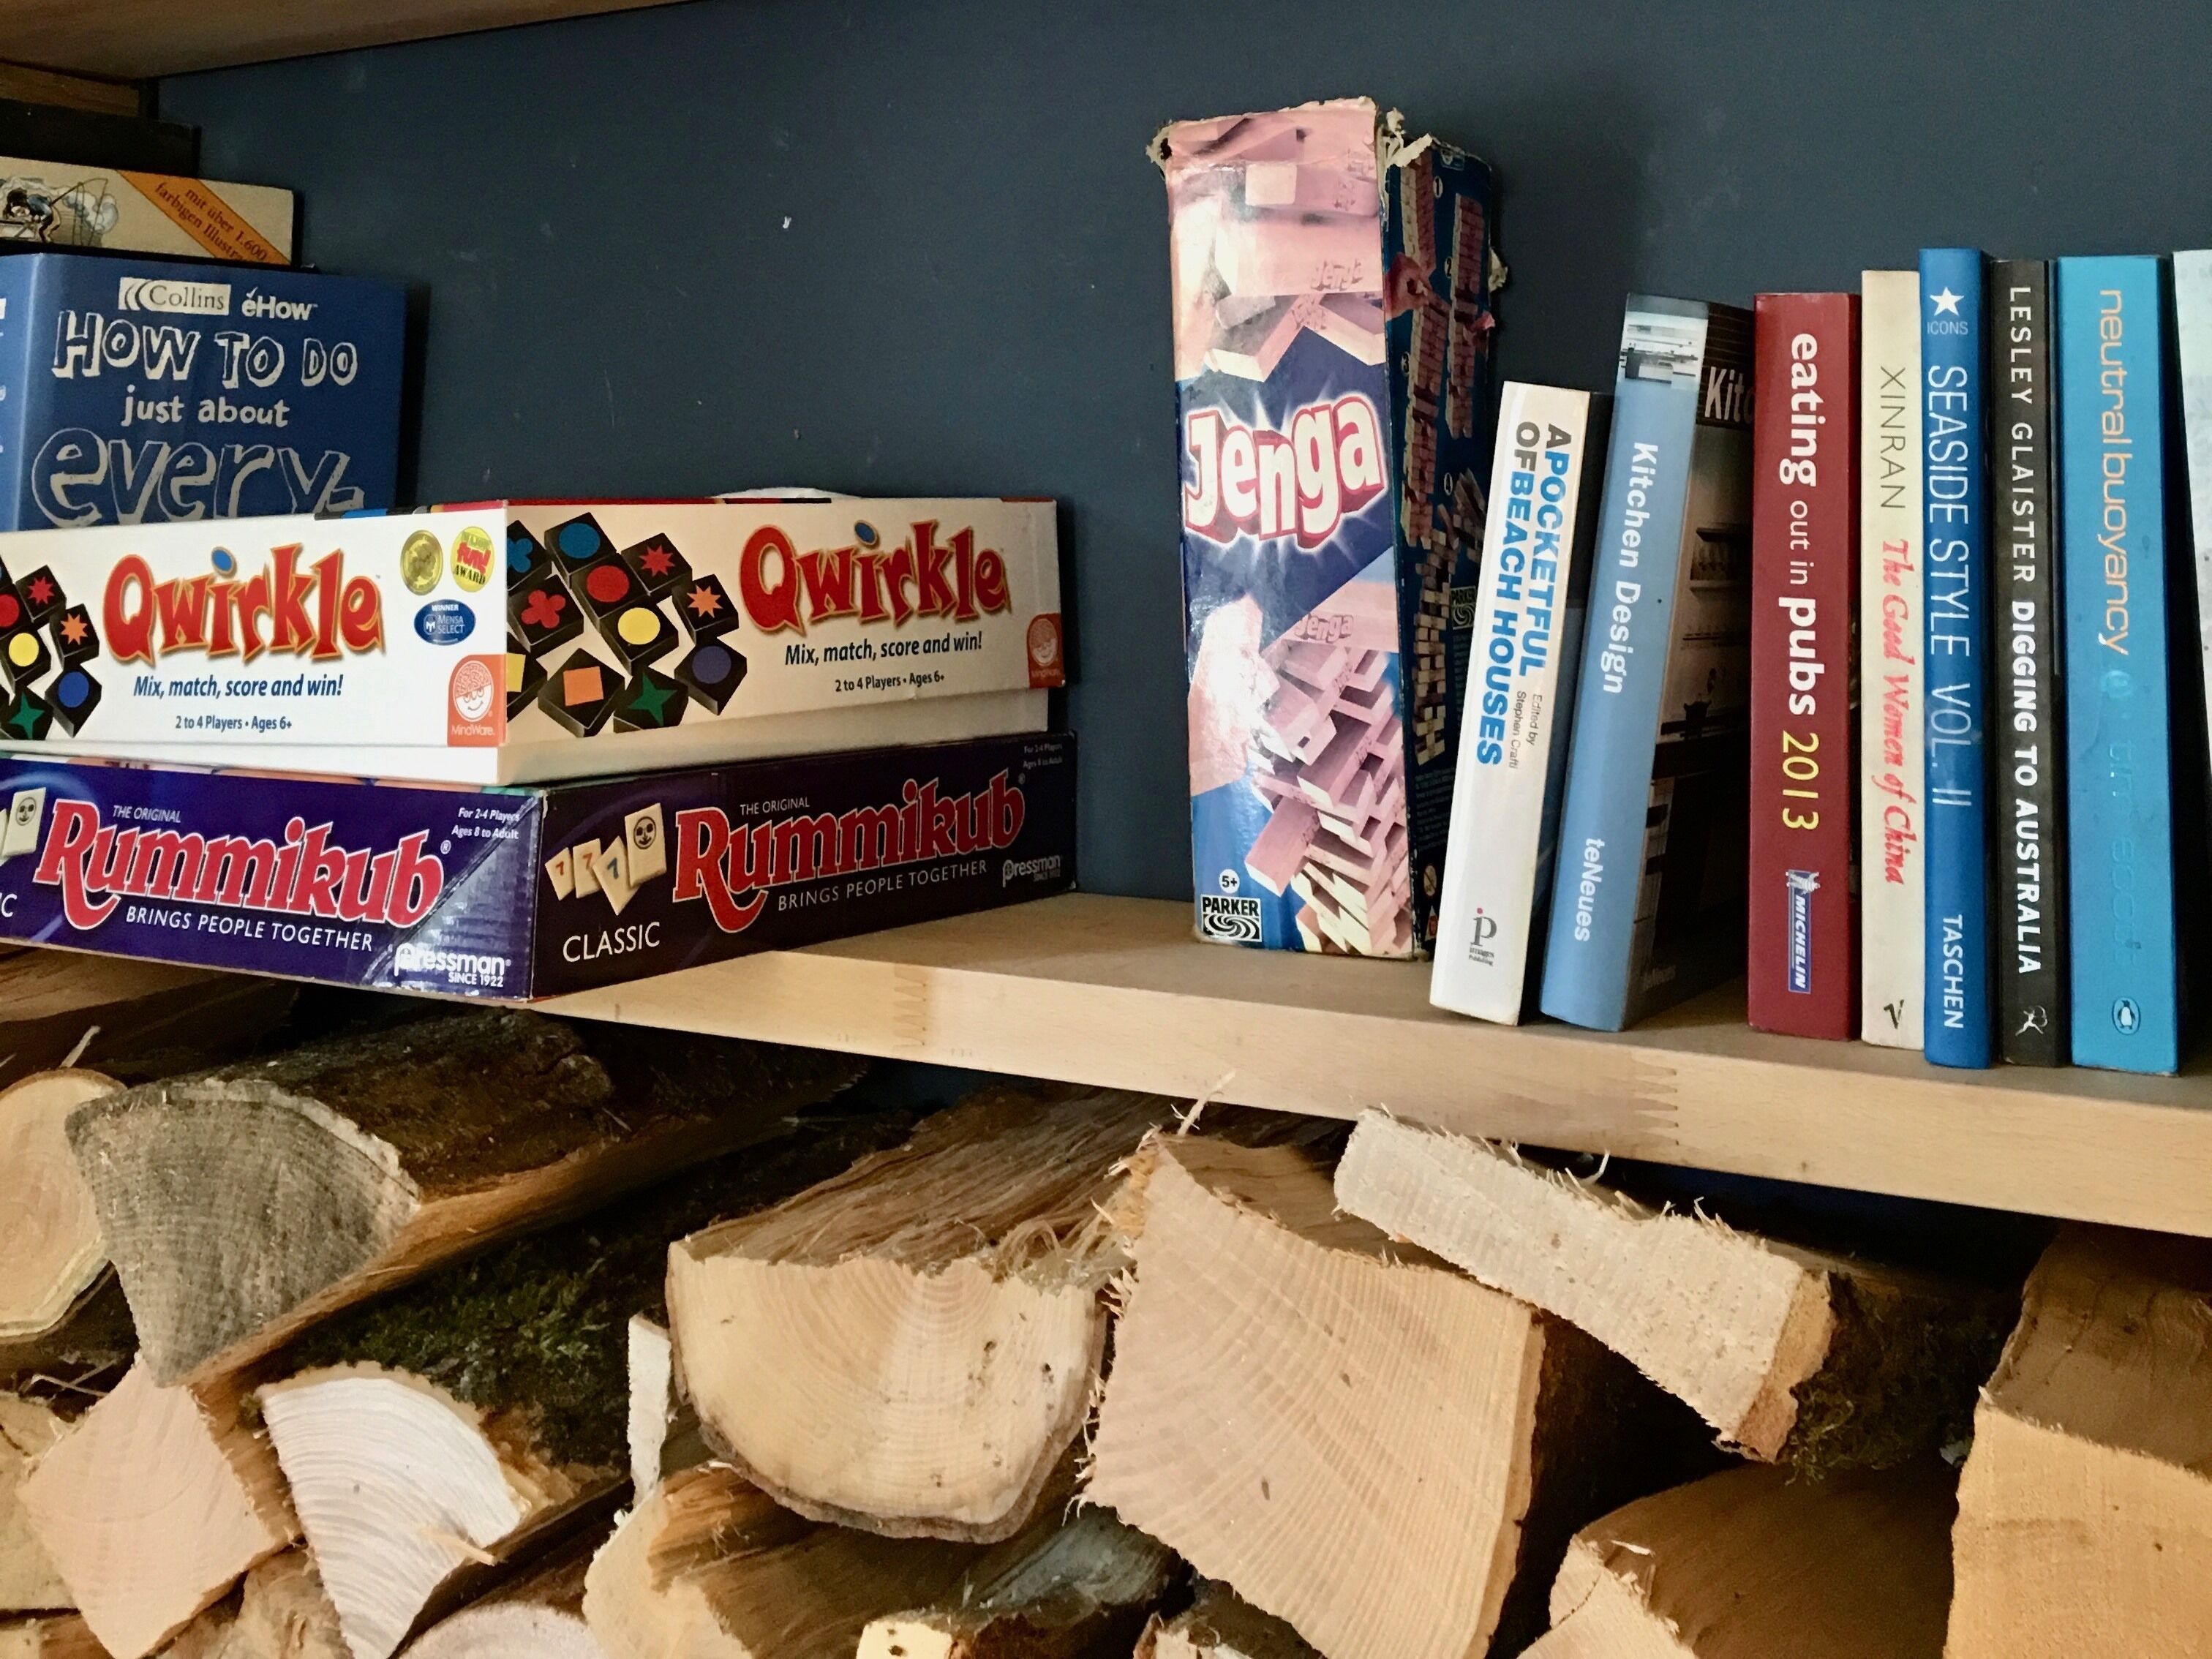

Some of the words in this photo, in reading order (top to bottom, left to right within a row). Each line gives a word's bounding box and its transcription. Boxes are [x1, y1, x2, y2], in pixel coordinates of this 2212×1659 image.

[154, 182, 203, 229] farbigen
[184, 188, 206, 208] mit
[208, 207, 235, 233] über
[235, 230, 268, 262] 1.600
[149, 283, 225, 311] Collins
[1926, 320, 1969, 336] ICONS
[52, 310, 201, 380] HOW
[215, 331, 286, 389] TO
[301, 336, 358, 387] DO
[2009, 286, 2034, 405] LESLEY
[2099, 288, 2133, 445] neutral
[121, 385, 185, 427] just
[198, 398, 290, 427] about
[1778, 333, 1826, 488] eating
[1880, 365, 1907, 510] XINRAN
[1184, 395, 1385, 550] Jenga
[1927, 365, 1969, 526] SEASIDE
[1619, 441, 1659, 569] Kitchen
[1789, 500, 1811, 552] out
[2011, 422, 2036, 583] GLAISTER
[1496, 471, 1535, 601] BEACH
[1519, 451, 1570, 677] POCKETFUL
[1882, 538, 1916, 587] The
[2097, 451, 2134, 656] buoyancy
[102, 543, 387, 667] Qwirkle
[454, 564, 486, 585] AWARD
[739, 519, 1013, 636] Qwirkle
[1789, 561, 1816, 586] in
[1930, 538, 1971, 658] STYLE
[432, 603, 459, 612] WINNER
[438, 614, 464, 625] MENSA
[438, 624, 465, 634] SELECT
[1600, 579, 1641, 694] Design
[1882, 593, 1916, 668] Good
[785, 644, 821, 666] Mix,
[824, 640, 878, 663] match,
[881, 640, 919, 658] score
[922, 635, 951, 655] and
[953, 631, 983, 652] win!
[1778, 596, 1826, 716] pubs
[2012, 601, 2038, 733] DIGGING
[132, 674, 166, 698] Mix,
[168, 676, 221, 699] match,
[226, 679, 271, 698] score
[274, 676, 304, 697] and
[306, 673, 343, 696] win!
[835, 679, 842, 692] 2
[843, 678, 854, 691] to
[856, 677, 863, 690] 4
[865, 674, 902, 691] Players
[908, 672, 932, 688] Ages
[933, 672, 945, 685] 6+
[1477, 609, 1519, 767] HOUSES
[1513, 690, 1528, 737] Stephen
[1530, 693, 1543, 729] Edited
[176, 715, 182, 729] 2
[184, 716, 194, 729] to
[196, 715, 203, 729] 4
[206, 715, 243, 733] Players
[251, 715, 278, 732] Ages
[279, 715, 293, 730] 6+
[1526, 729, 1538, 746] by
[1882, 673, 1911, 768] Women
[1930, 682, 1972, 769] VOL.
[1781, 730, 1821, 831] 2013
[1871, 773, 1918, 805] of
[1931, 787, 1973, 807] II
[2013, 744, 2039, 787] TO
[113, 805, 132, 819] THE
[133, 807, 182, 824] ORIGINAL
[451, 824, 473, 839] Ages
[474, 826, 480, 837] 8
[481, 827, 492, 838] to
[492, 827, 519, 840] Adult
[458, 806, 474, 819] For
[475, 808, 488, 820] 2-4
[489, 808, 520, 824] Players
[740, 803, 760, 816] THE
[761, 796, 810, 814] ORIGINAL
[33, 798, 445, 930] Rummikub
[672, 768, 1026, 933] Rummikub
[1882, 803, 1919, 886] China
[778, 888, 840, 912] BRINGS
[846, 875, 905, 899] PEOPLE
[909, 860, 988, 887] TOGETHER
[1202, 896, 1260, 917] PARKER
[1222, 875, 1238, 888] 5+
[1574, 837, 1606, 943] teNeues
[2014, 797, 2042, 975] AUSTRALIA
[126, 906, 191, 931] BRINGS
[198, 914, 265, 939] PEOPLE
[271, 922, 374, 952] TOGETHER
[563, 921, 661, 963] CLASSIC
[1793, 892, 1807, 990] MICHELIN
[448, 971, 478, 986] SINCE
[479, 974, 505, 988] 1922
[1941, 914, 1965, 1030] TASCHEN
